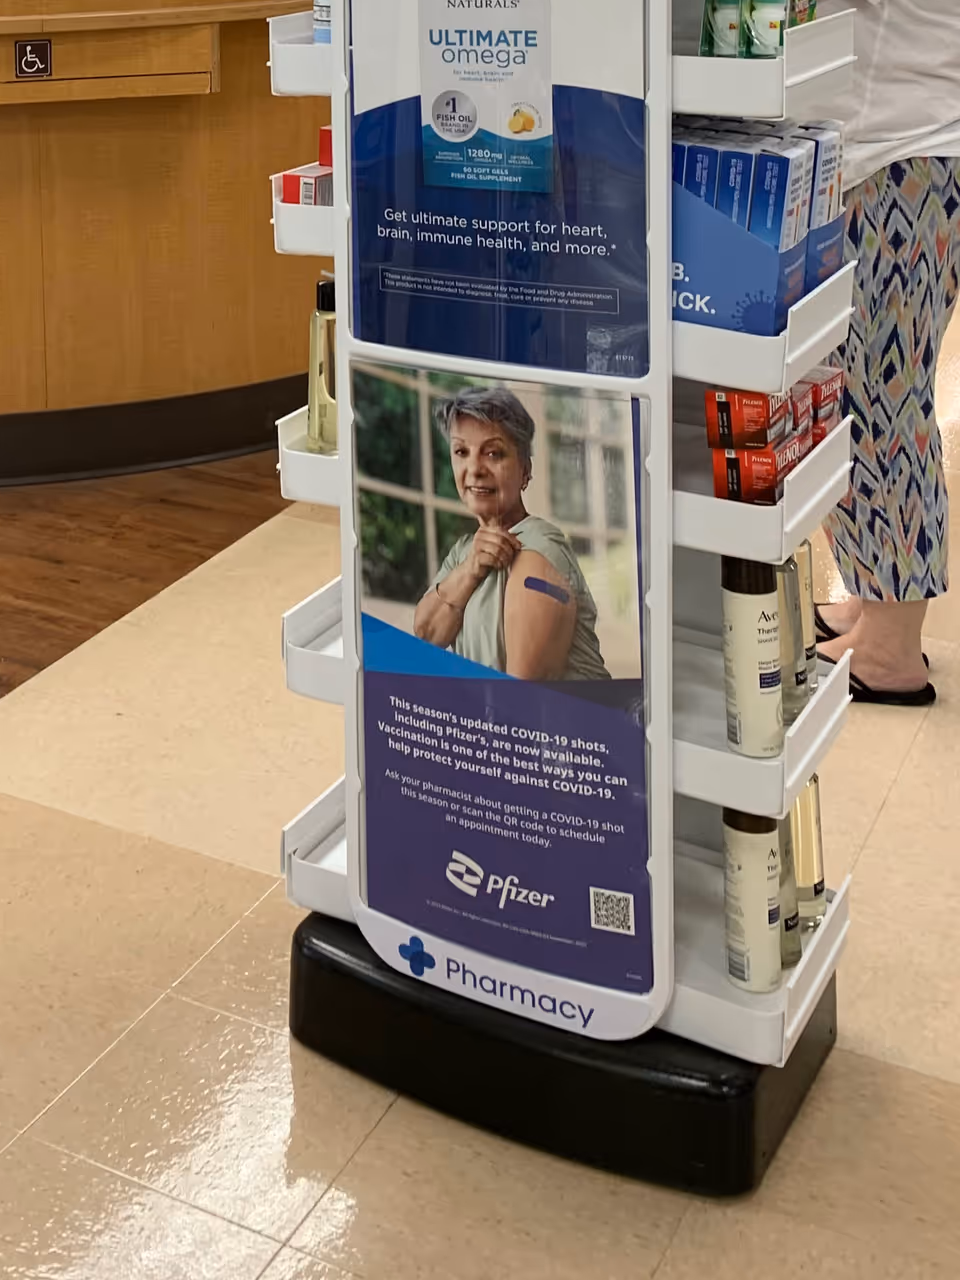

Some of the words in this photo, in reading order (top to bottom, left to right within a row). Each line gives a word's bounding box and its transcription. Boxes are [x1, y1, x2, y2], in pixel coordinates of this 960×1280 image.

[429, 29, 538, 47] ULTIMATE
[436, 113, 456, 122] FISH
[457, 115, 473, 123] OIL
[467, 148, 490, 158] 1280
[479, 174, 522, 183] SUPPLEMENT
[377, 224, 413, 242] brain,
[416, 228, 472, 246] immune
[476, 233, 527, 252] health,
[531, 239, 560, 254] and
[384, 208, 407, 222] Get
[411, 211, 467, 228] ultimate
[471, 218, 530, 235] support
[535, 220, 557, 234] for
[561, 222, 608, 239] heart,
[520, 286, 536, 294] Food
[536, 288, 548, 296] and
[549, 289, 565, 297] Drug
[389, 695, 410, 711] This
[412, 703, 458, 723] season's
[460, 716, 508, 735] updated
[511, 726, 568, 746] COVID-19
[570, 738, 609, 754] shots,
[378, 720, 438, 748] Vaccination
[452, 743, 473, 756] one
[475, 749, 488, 760] of
[490, 752, 510, 765] the
[513, 756, 539, 771] best
[542, 764, 574, 778] ways
[577, 770, 601, 782] you
[604, 774, 628, 786] can
[445, 725, 489, 747] Pfizer's,
[492, 739, 511, 751] are
[514, 744, 540, 756] now
[543, 748, 605, 768] available.
[388, 738, 410, 754] help
[413, 746, 452, 766] protect
[454, 759, 502, 778] yourself
[504, 771, 549, 789] against
[552, 780, 616, 800] COVID-19.
[385, 768, 400, 780] Ask
[400, 774, 420, 786] your
[422, 780, 472, 802] pharmacist
[474, 795, 502, 810] about
[504, 803, 539, 820] getting
[541, 812, 548, 820] a
[550, 812, 599, 829] COVID-19
[601, 821, 625, 834] shot
[401, 786, 417, 798] this
[418, 794, 448, 808] season
[450, 802, 460, 811] or
[462, 805, 483, 817] scan
[485, 810, 501, 822] the
[503, 815, 518, 826] QR
[520, 820, 544, 832] code
[546, 825, 557, 835] to
[559, 827, 605, 844] schedule
[445, 813, 457, 824] an
[458, 817, 519, 841] appointment
[521, 832, 552, 848] today.
[486, 875, 555, 909] Pfizer
[446, 957, 595, 1029] Pharmacy
